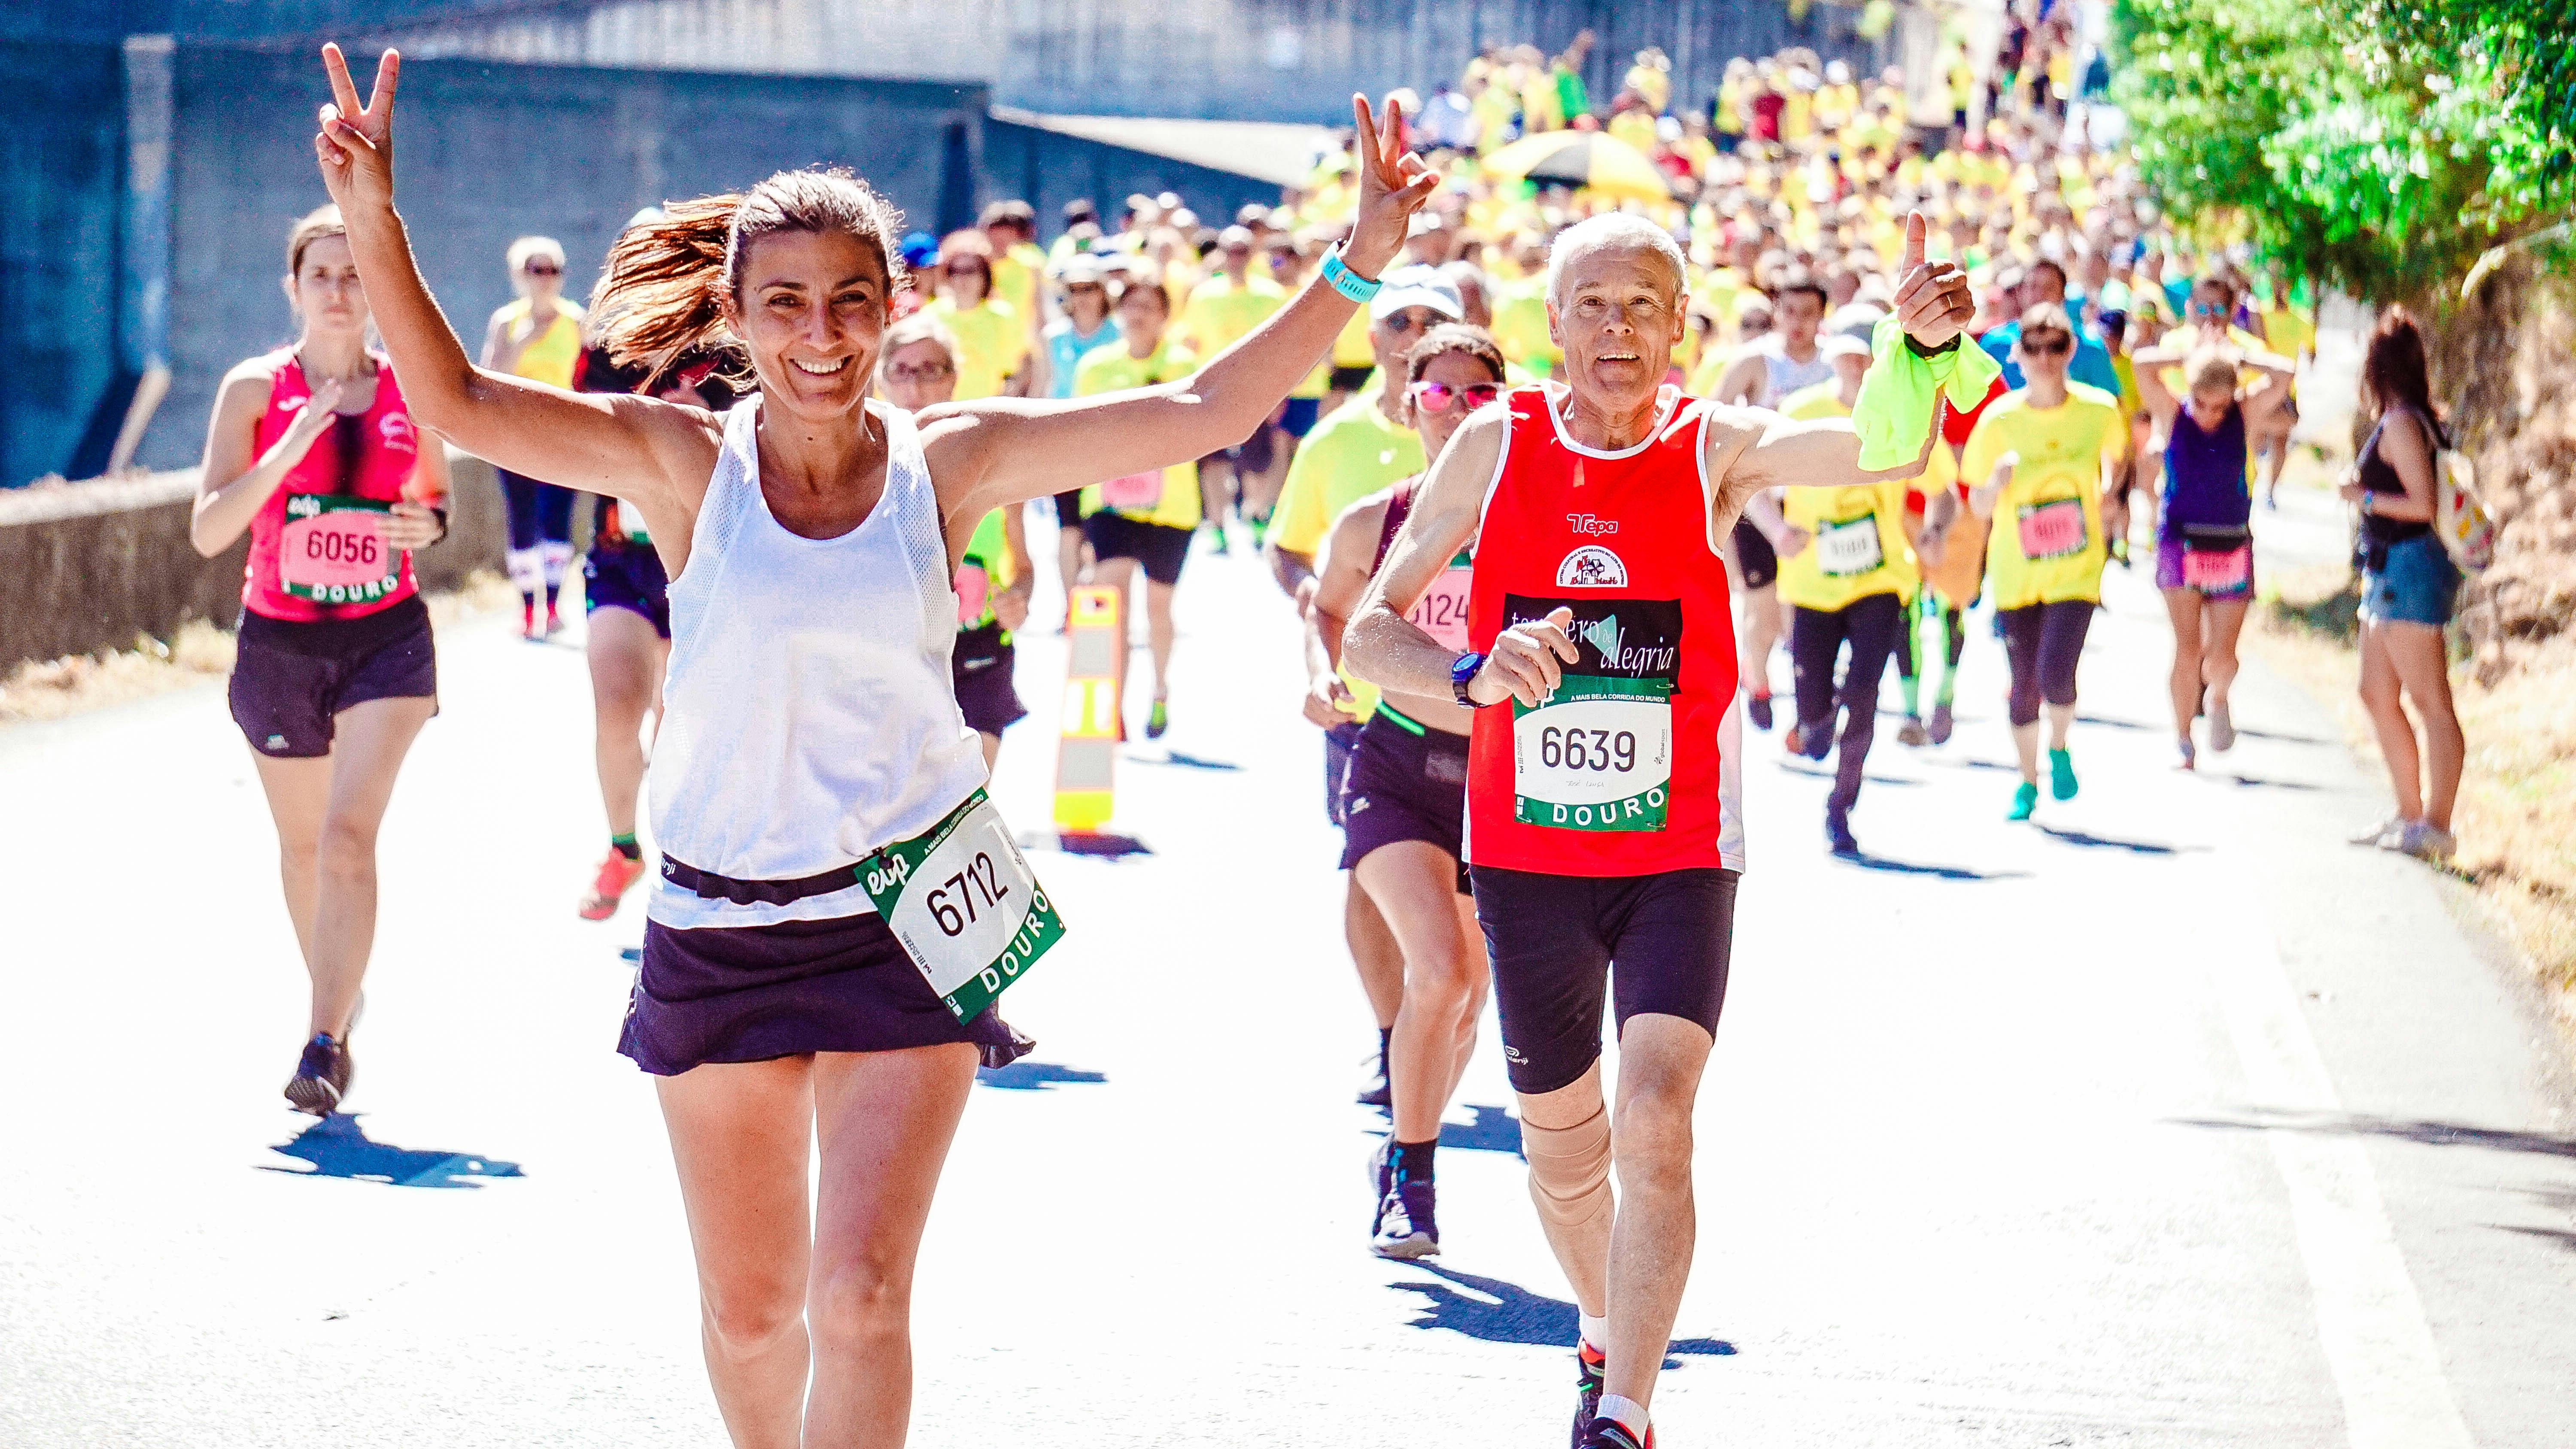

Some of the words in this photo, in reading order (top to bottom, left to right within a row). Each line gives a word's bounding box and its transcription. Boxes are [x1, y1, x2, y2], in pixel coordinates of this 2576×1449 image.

[307, 530, 377, 564] 6056
[312, 574, 398, 601] DOURO
[1601, 627, 1674, 678] alegria
[1603, 628, 1613, 643] de
[1542, 726, 1635, 772] 6639
[1553, 788, 1664, 825] DOURO
[928, 835, 942, 851] MAIS
[940, 824, 953, 838] BELA
[927, 852, 1009, 937] 6712
[980, 890, 1048, 993] DOURO
